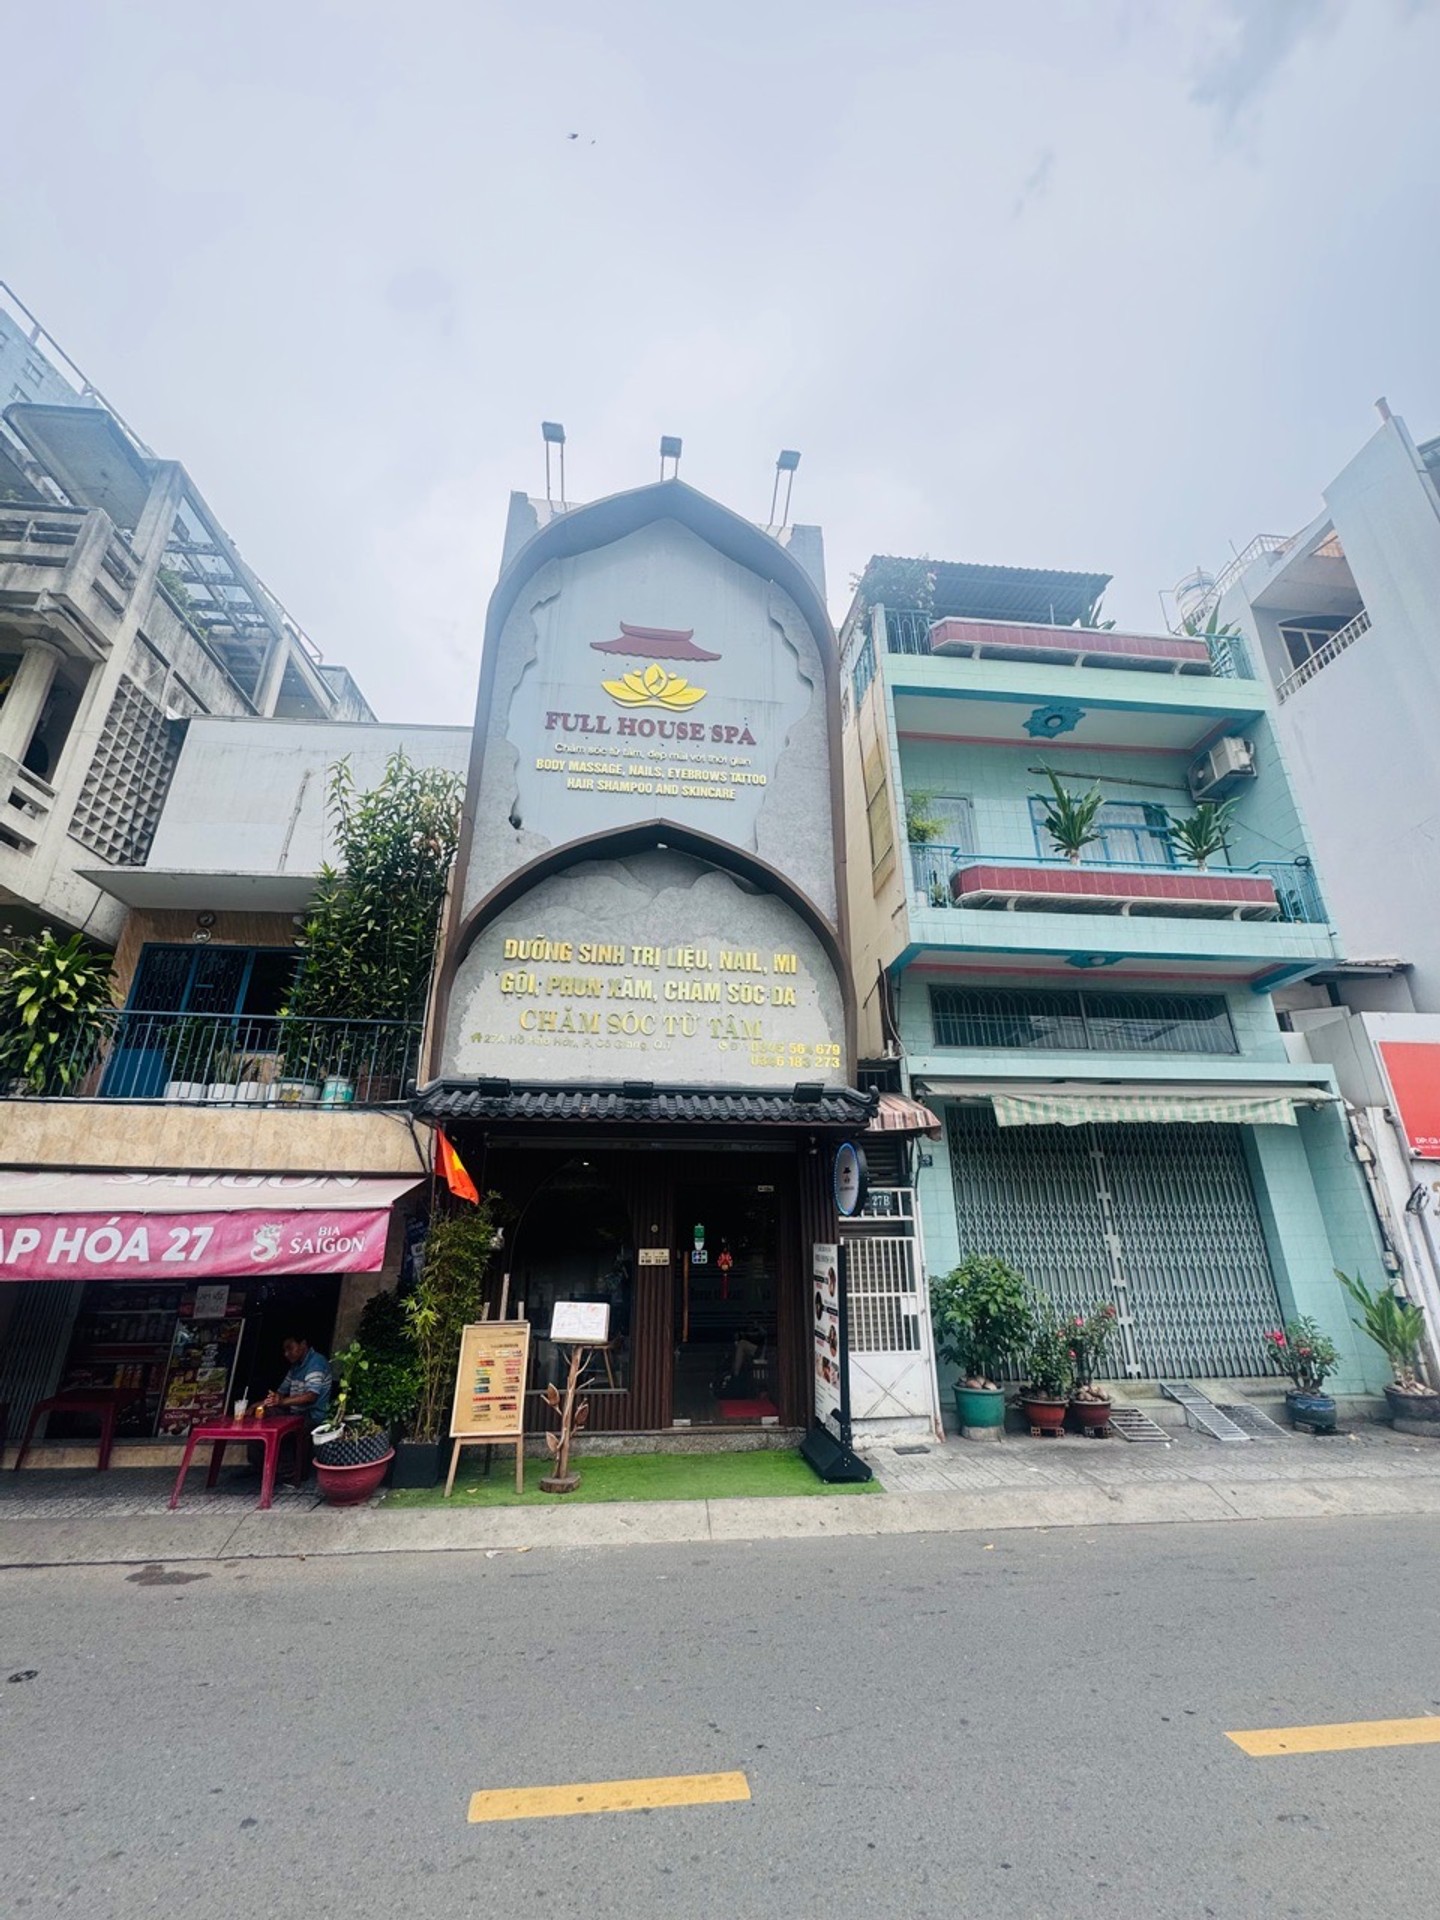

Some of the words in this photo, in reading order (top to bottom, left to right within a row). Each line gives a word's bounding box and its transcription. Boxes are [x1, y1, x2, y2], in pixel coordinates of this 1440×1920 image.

[545, 711, 612, 735] FULL
[617, 717, 706, 742] HOUSE
[536, 758, 566, 773] BODY
[667, 768, 728, 784] EYEBROWS
[730, 771, 767, 787] TATTOO
[567, 777, 594, 792] HAIR
[597, 779, 653, 796] SHAMPOO
[655, 783, 679, 798] AND
[681, 785, 737, 801] SKINCARE
[577, 942, 626, 967] SINH
[631, 946, 661, 972] TRỊ
[719, 950, 768, 976] NAIL,
[773, 953, 798, 975] MI
[546, 975, 601, 1000] PHUN
[664, 978, 721, 1004] CHĂM
[727, 981, 766, 1006] SÓC
[770, 986, 797, 1007] DA
[519, 1004, 602, 1035] CHĂM
[606, 1009, 657, 1036] SÓC
[664, 1011, 699, 1038] TỪ
[709, 1013, 763, 1041] TÂM
[815, 1043, 840, 1056] 679
[815, 1056, 840, 1069] 273
[871, 1195, 891, 1207] 27B
[0, 1229, 41, 1265] P
[46, 1216, 150, 1264] HÓA
[161, 1226, 214, 1262] 27
[318, 1226, 341, 1237] BIA
[289, 1237, 366, 1254] SAIGON
